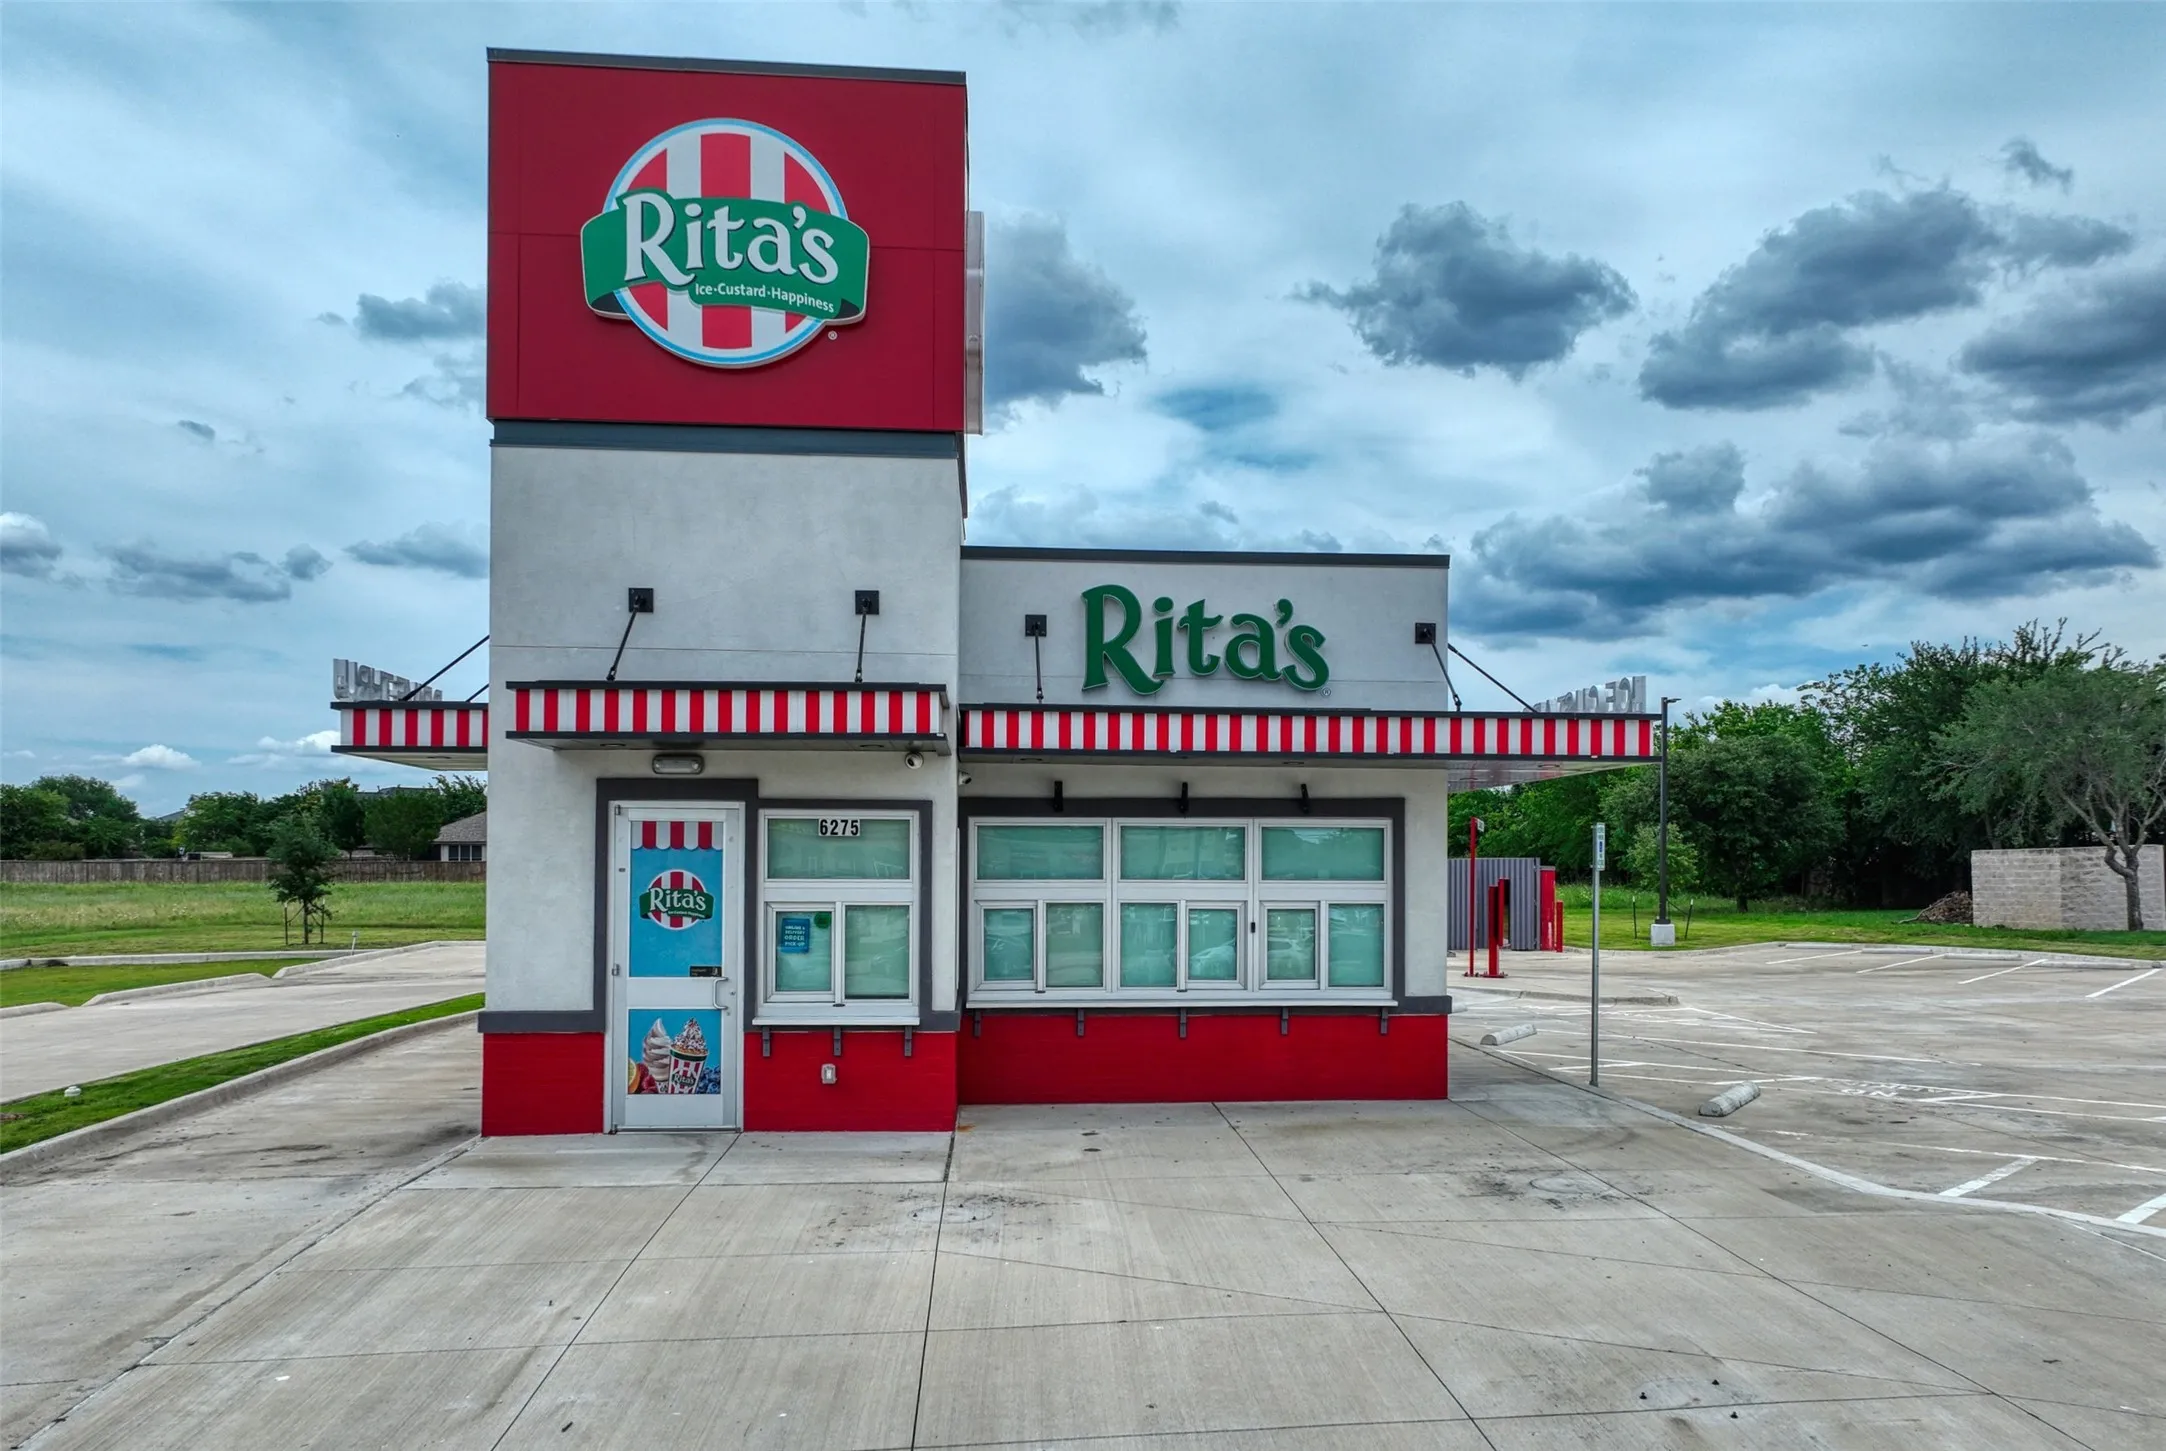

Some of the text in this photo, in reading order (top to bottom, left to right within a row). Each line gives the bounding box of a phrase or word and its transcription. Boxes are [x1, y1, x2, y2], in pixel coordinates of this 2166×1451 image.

[623, 192, 839, 286] Rita's
[1082, 584, 1330, 695] Rita's
[820, 819, 859, 836] 6275
[649, 887, 706, 912] Rita's
